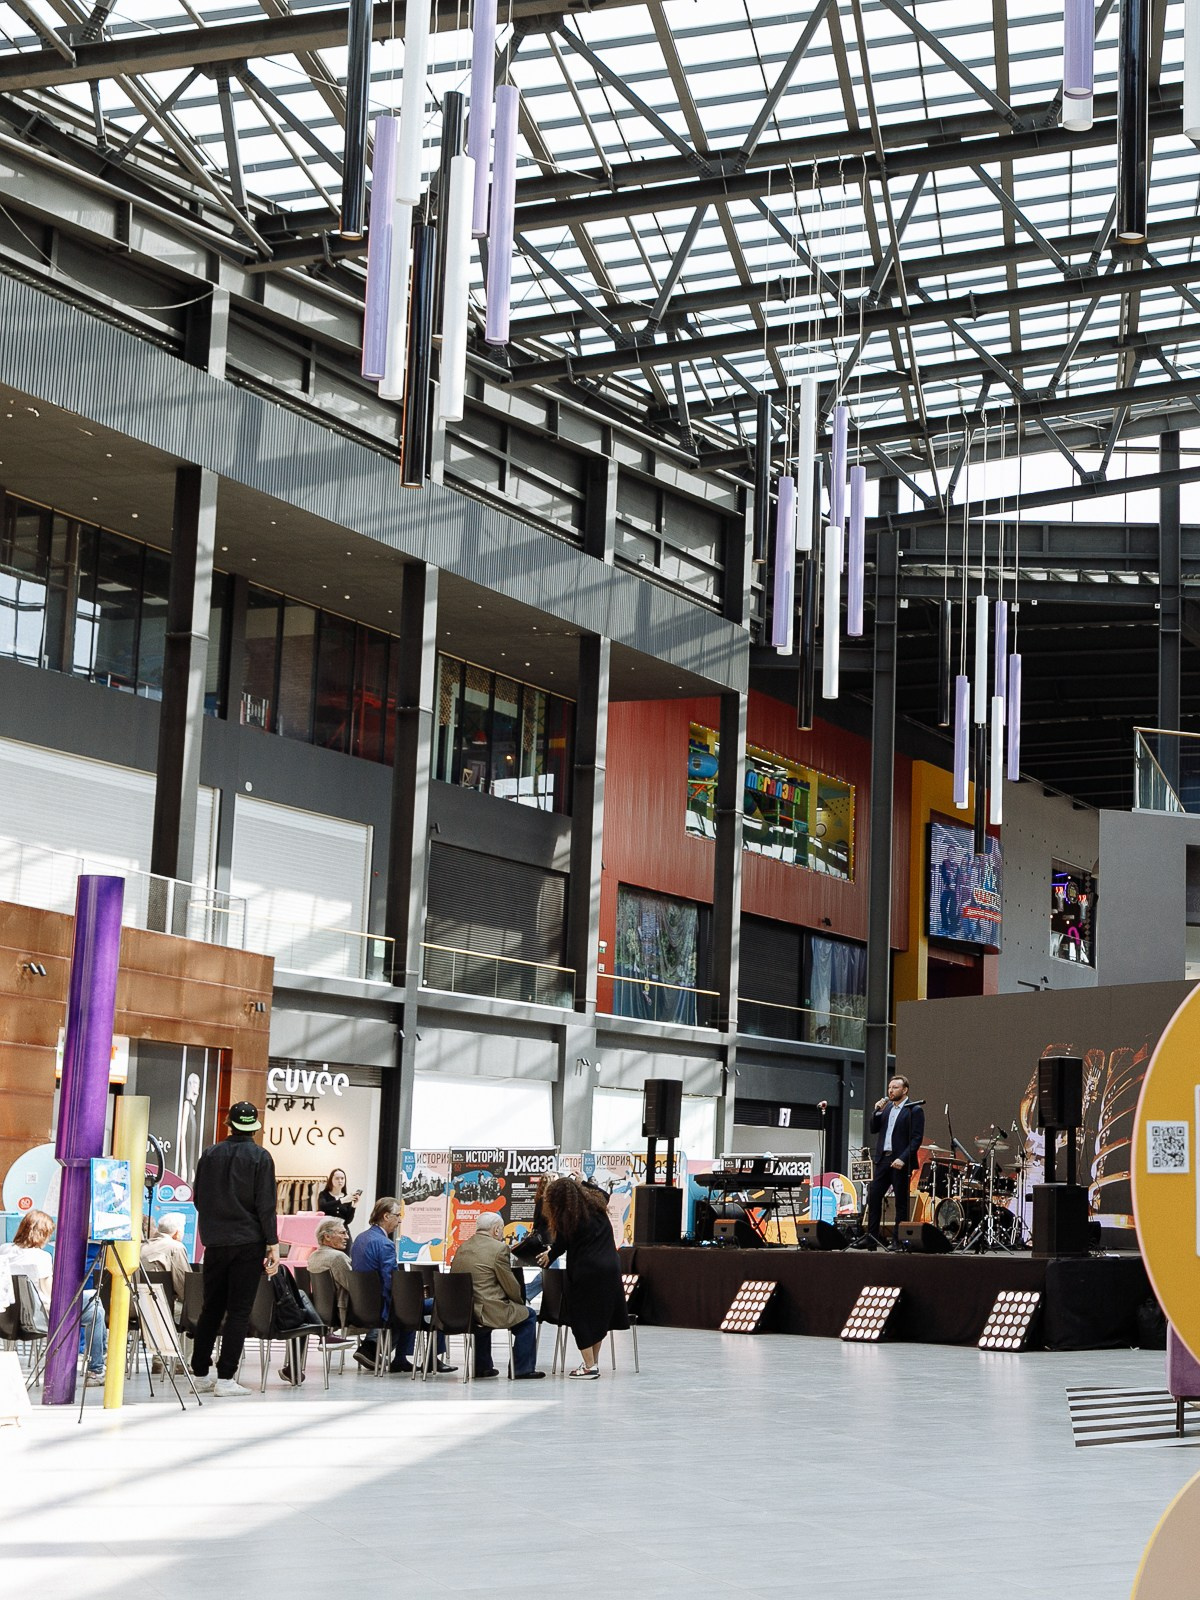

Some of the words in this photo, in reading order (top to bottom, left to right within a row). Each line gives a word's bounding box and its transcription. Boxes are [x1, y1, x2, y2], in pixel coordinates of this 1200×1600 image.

[466, 1151, 505, 1163] ИСТОРИЯ
[504, 1150, 556, 1176] Джаза
[559, 1157, 581, 1168] ИСТОР
[596, 1155, 631, 1166] ИСТОРИЯ
